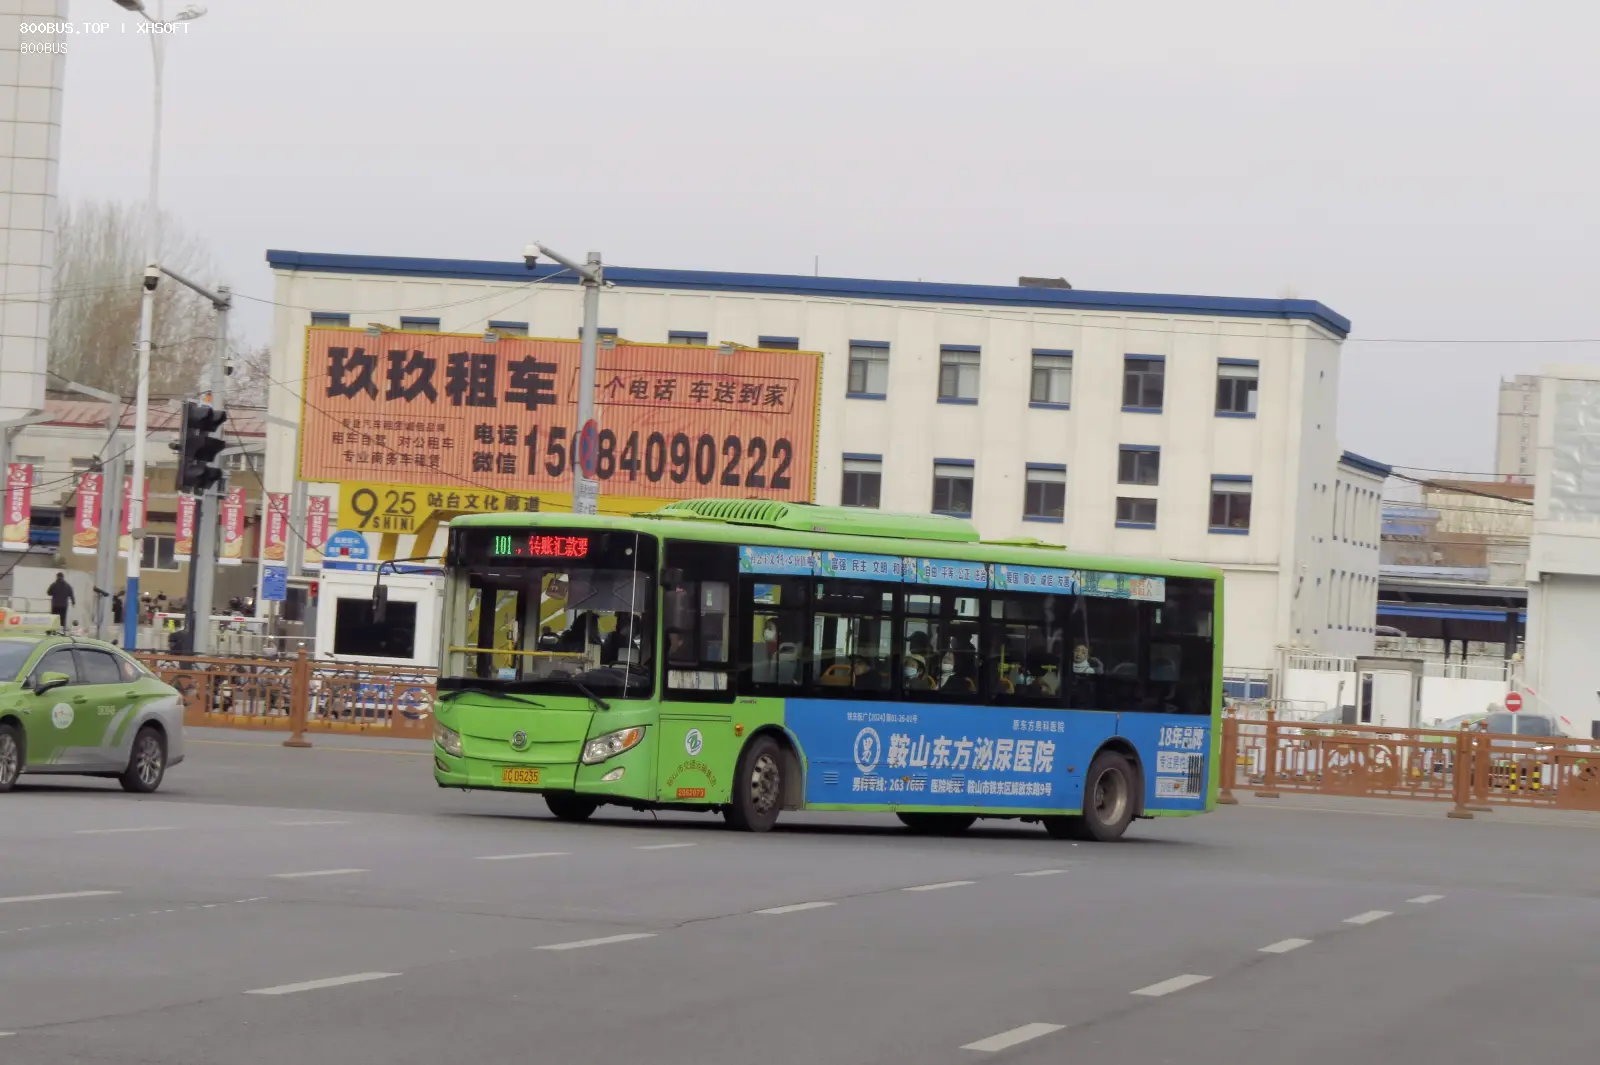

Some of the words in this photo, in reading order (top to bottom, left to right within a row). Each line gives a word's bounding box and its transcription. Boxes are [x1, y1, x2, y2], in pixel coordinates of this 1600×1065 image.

[326, 346, 558, 411] 玖玖租车
[594, 375, 677, 402] 个电话
[689, 379, 789, 407] 车送到家
[473, 422, 518, 447] 电话
[472, 451, 518, 475] 微信
[525, 424, 793, 490] 1584090222
[427, 491, 541, 512] 站台文化廊道
[495, 535, 512, 555] 101
[831, 557, 847, 572] 富强
[852, 559, 867, 573] 民主
[872, 561, 888, 574] 文明
[925, 565, 938, 578] 自由
[941, 566, 954, 579] 平等
[958, 567, 970, 581] 公正
[886, 732, 1056, 773] 鞍山东方泌尿医院
